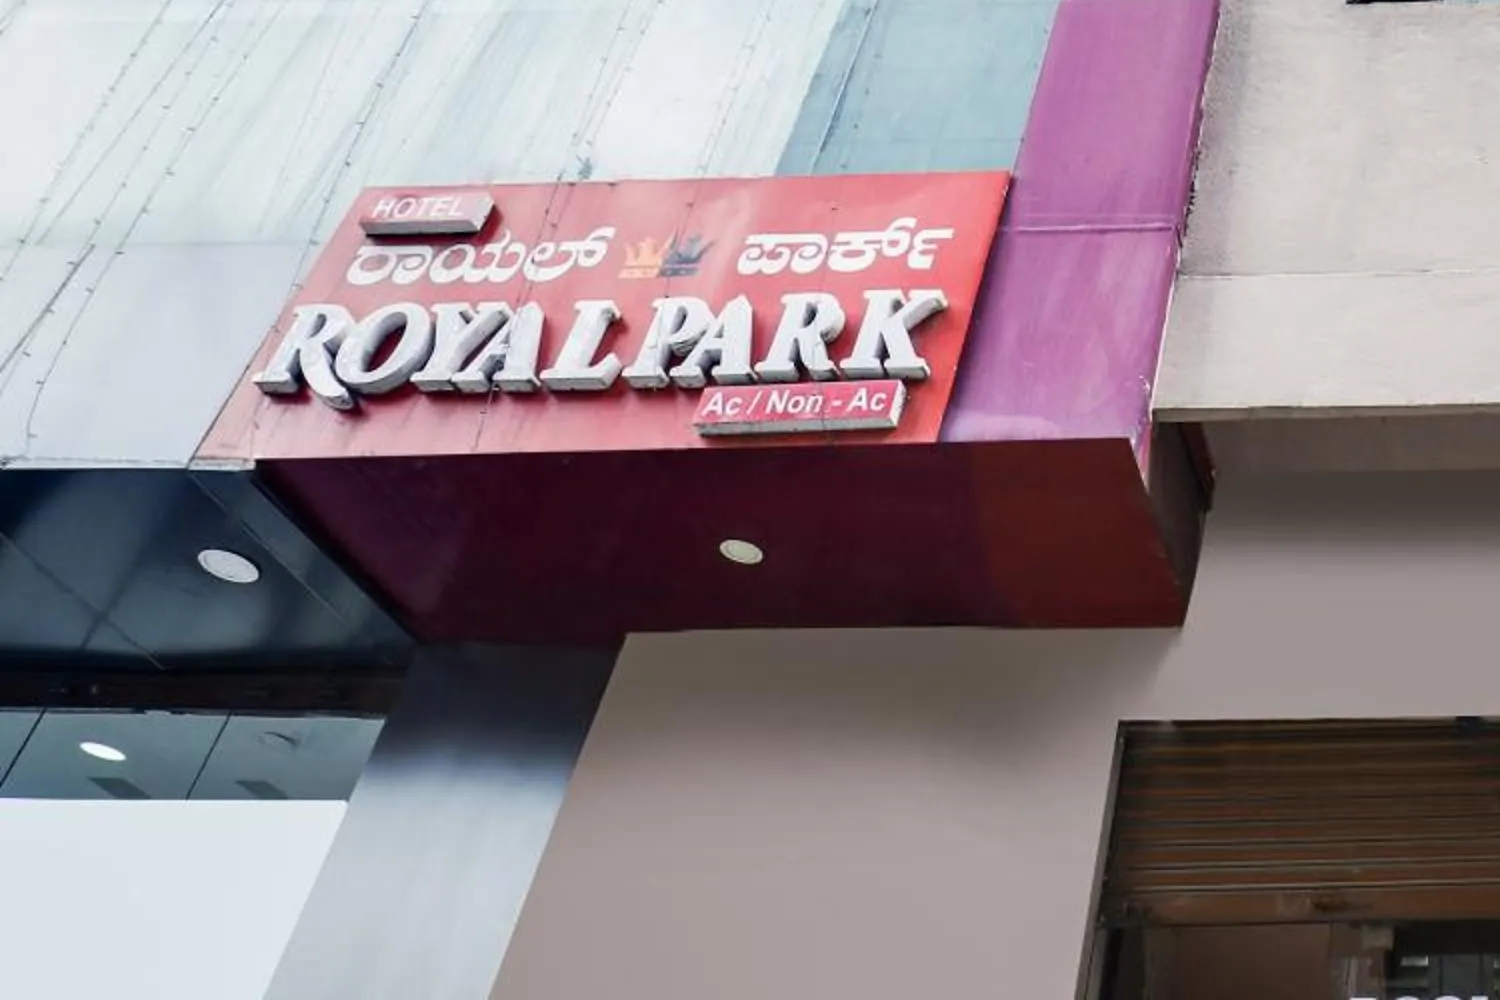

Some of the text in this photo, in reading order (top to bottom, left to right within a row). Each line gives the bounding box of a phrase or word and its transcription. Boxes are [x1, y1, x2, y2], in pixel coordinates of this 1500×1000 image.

[371, 195, 465, 219] HOTEL
[252, 288, 948, 409] ROYAL PARK
